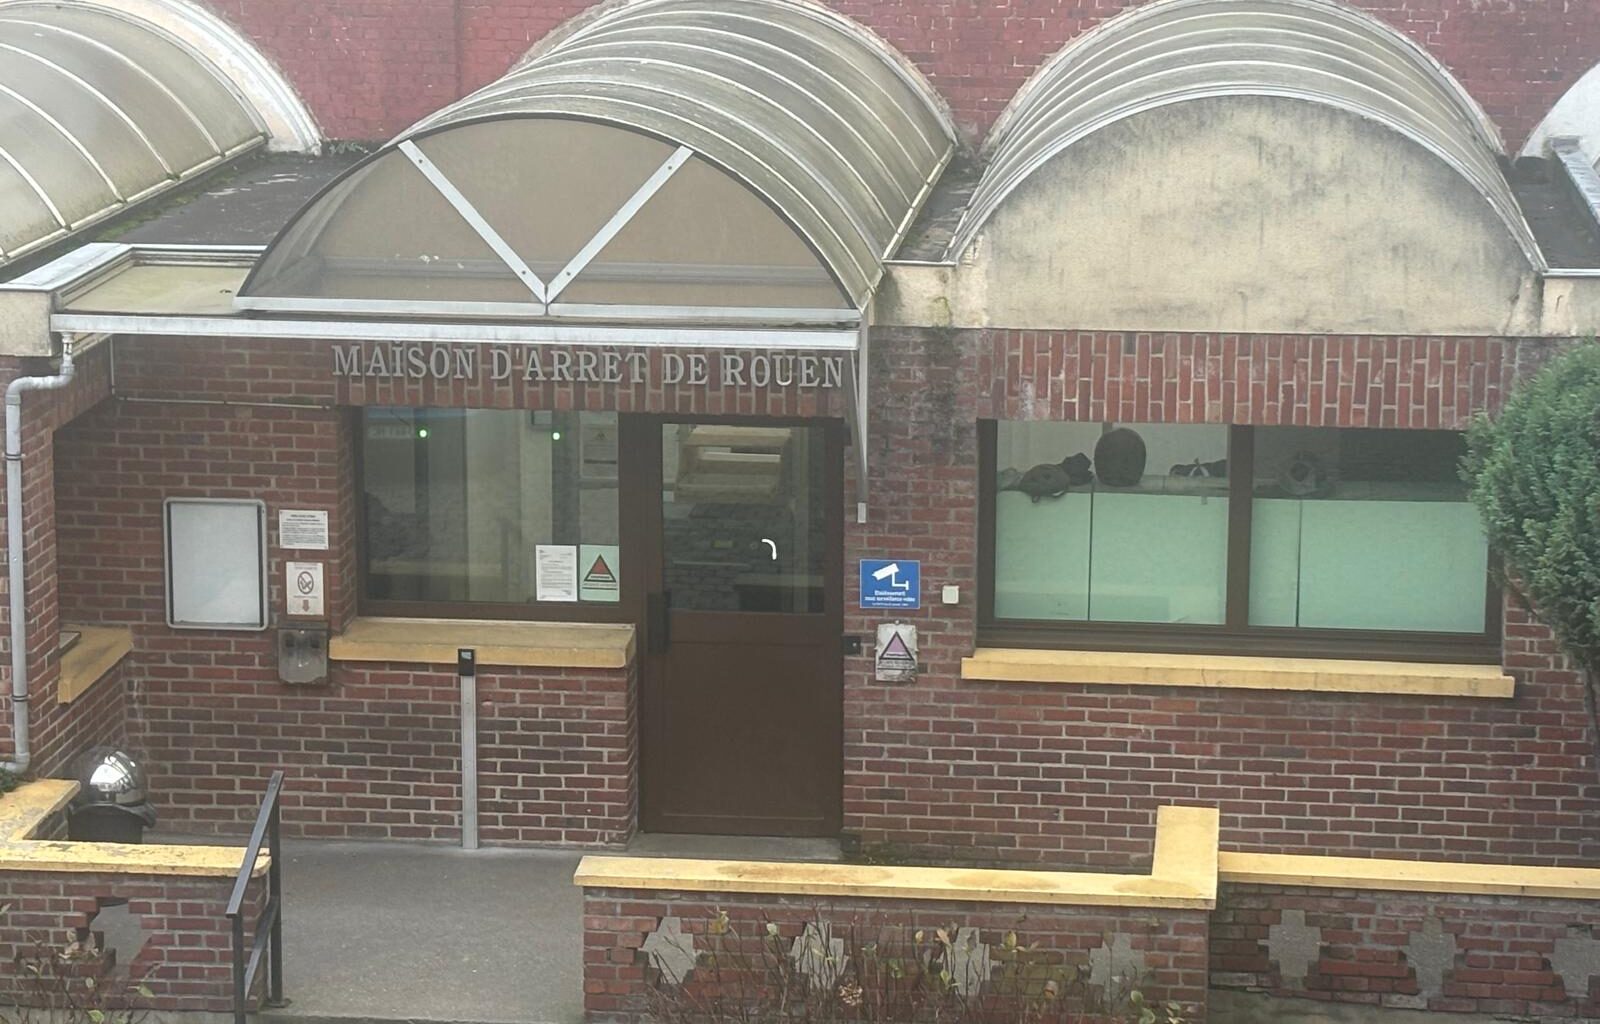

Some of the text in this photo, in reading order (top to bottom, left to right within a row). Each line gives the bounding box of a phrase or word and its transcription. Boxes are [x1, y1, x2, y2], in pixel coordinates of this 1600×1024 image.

[331, 344, 476, 379] MAISON
[663, 352, 709, 385] DE
[723, 353, 844, 388] ROUEN
